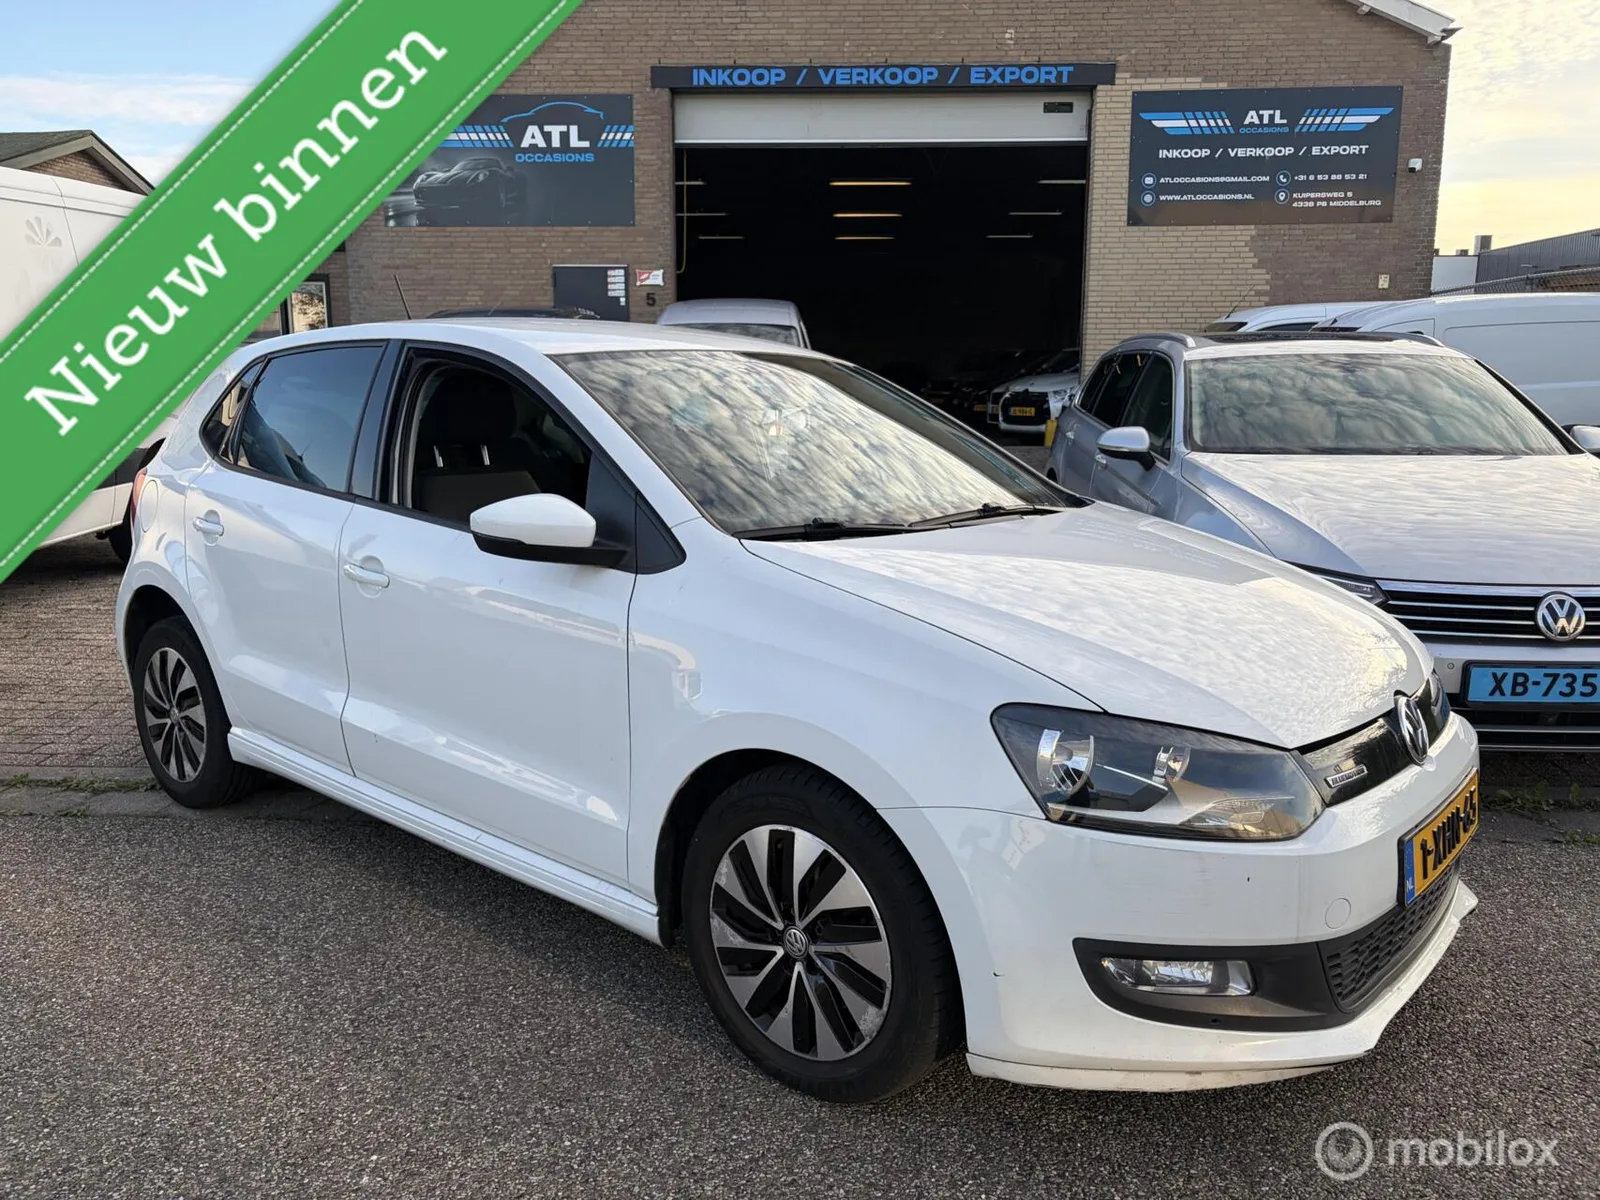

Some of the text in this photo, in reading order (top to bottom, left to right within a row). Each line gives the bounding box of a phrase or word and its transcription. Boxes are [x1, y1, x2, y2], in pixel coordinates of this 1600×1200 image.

[692, 65, 1075, 87] INKOOP / VERKOOP / EXPORT
[1243, 110, 1288, 125] ATL
[520, 125, 591, 149] ATL
[1239, 126, 1290, 135] OCCASIONS
[515, 153, 595, 163] OCCASIONS
[1159, 145, 1369, 159] INKOOP / VERKOOP / EXPORT
[1159, 193, 1255, 201] WWW.ATLOCCASIONS.NL
[1293, 191, 1345, 199] KUIPERSWEG
[1329, 199, 1382, 207] MIDDELBURG
[646, 292, 657, 307] 5
[1488, 671, 1598, 698] XB-735
